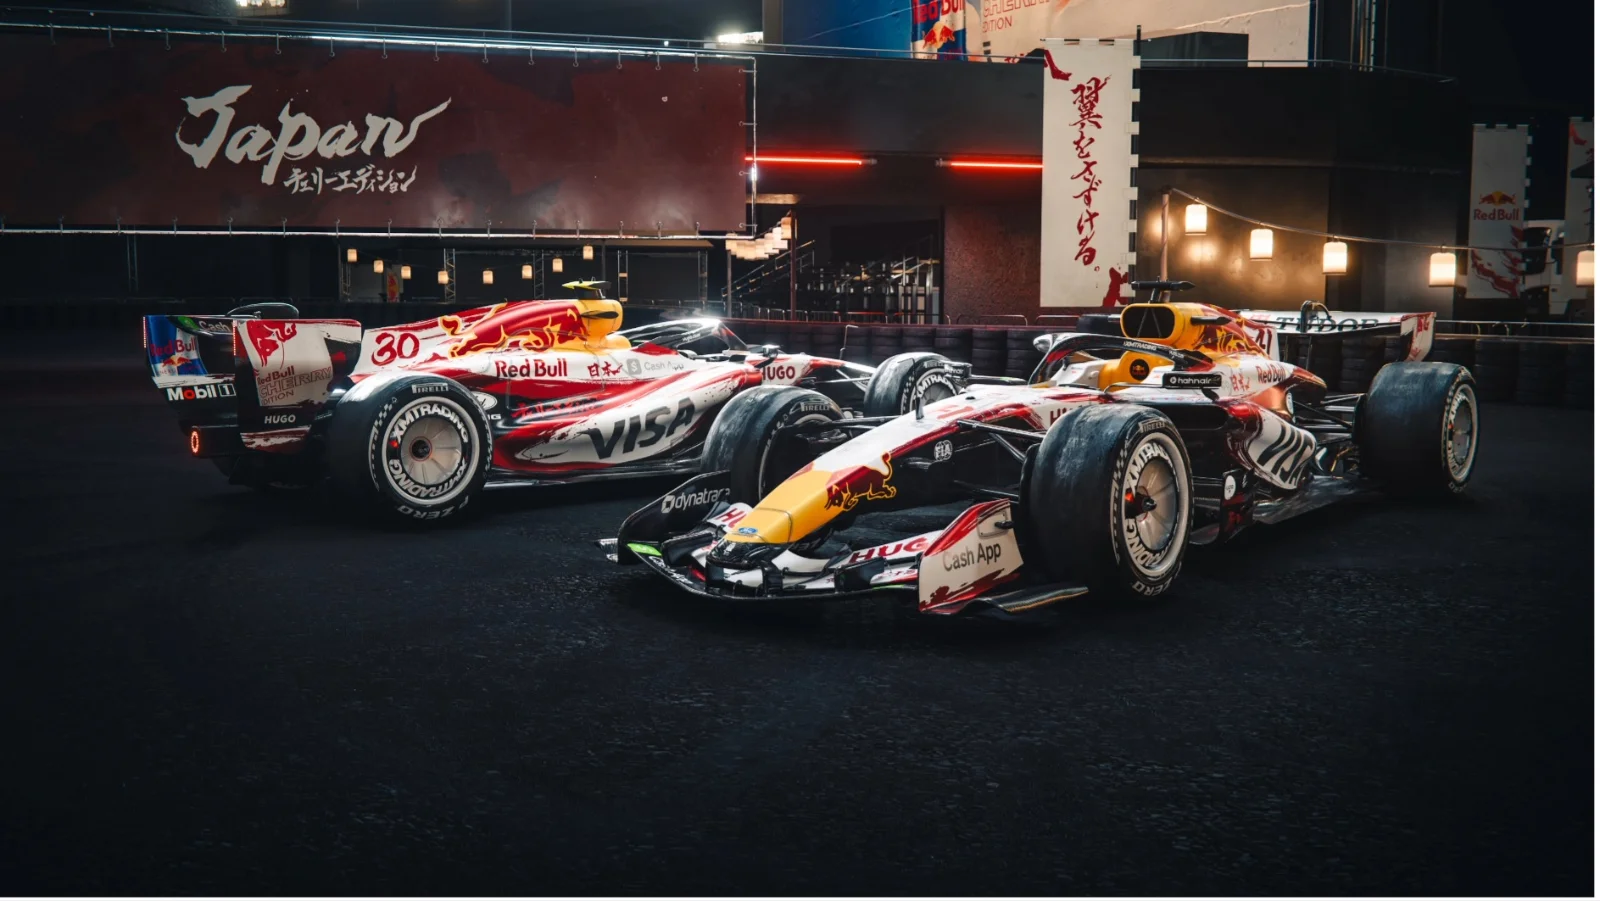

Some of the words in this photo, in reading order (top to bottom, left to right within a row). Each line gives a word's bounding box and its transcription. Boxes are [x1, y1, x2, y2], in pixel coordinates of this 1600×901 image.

[176, 84, 451, 185] Japan
[283, 164, 418, 195] チェリーエディション
[1473, 208, 1496, 221] Red
[1497, 208, 1520, 221] Bull
[150, 340, 174, 356] Red
[175, 336, 196, 353] Bull
[371, 332, 420, 366] 30
[272, 366, 294, 380] Bull
[495, 358, 530, 378] Red
[534, 358, 567, 377] Bull
[587, 361, 620, 378] 日本
[644, 361, 665, 371] Cash
[1256, 365, 1272, 384] Red
[166, 384, 217, 401] Mobil
[412, 383, 449, 394] PIRELLI
[264, 414, 296, 424] HUGO
[390, 403, 469, 444] XMTRADING
[585, 397, 695, 460] VISA
[397, 505, 455, 520] ZERO
[943, 551, 975, 572] Cash
[977, 542, 1002, 564] App
